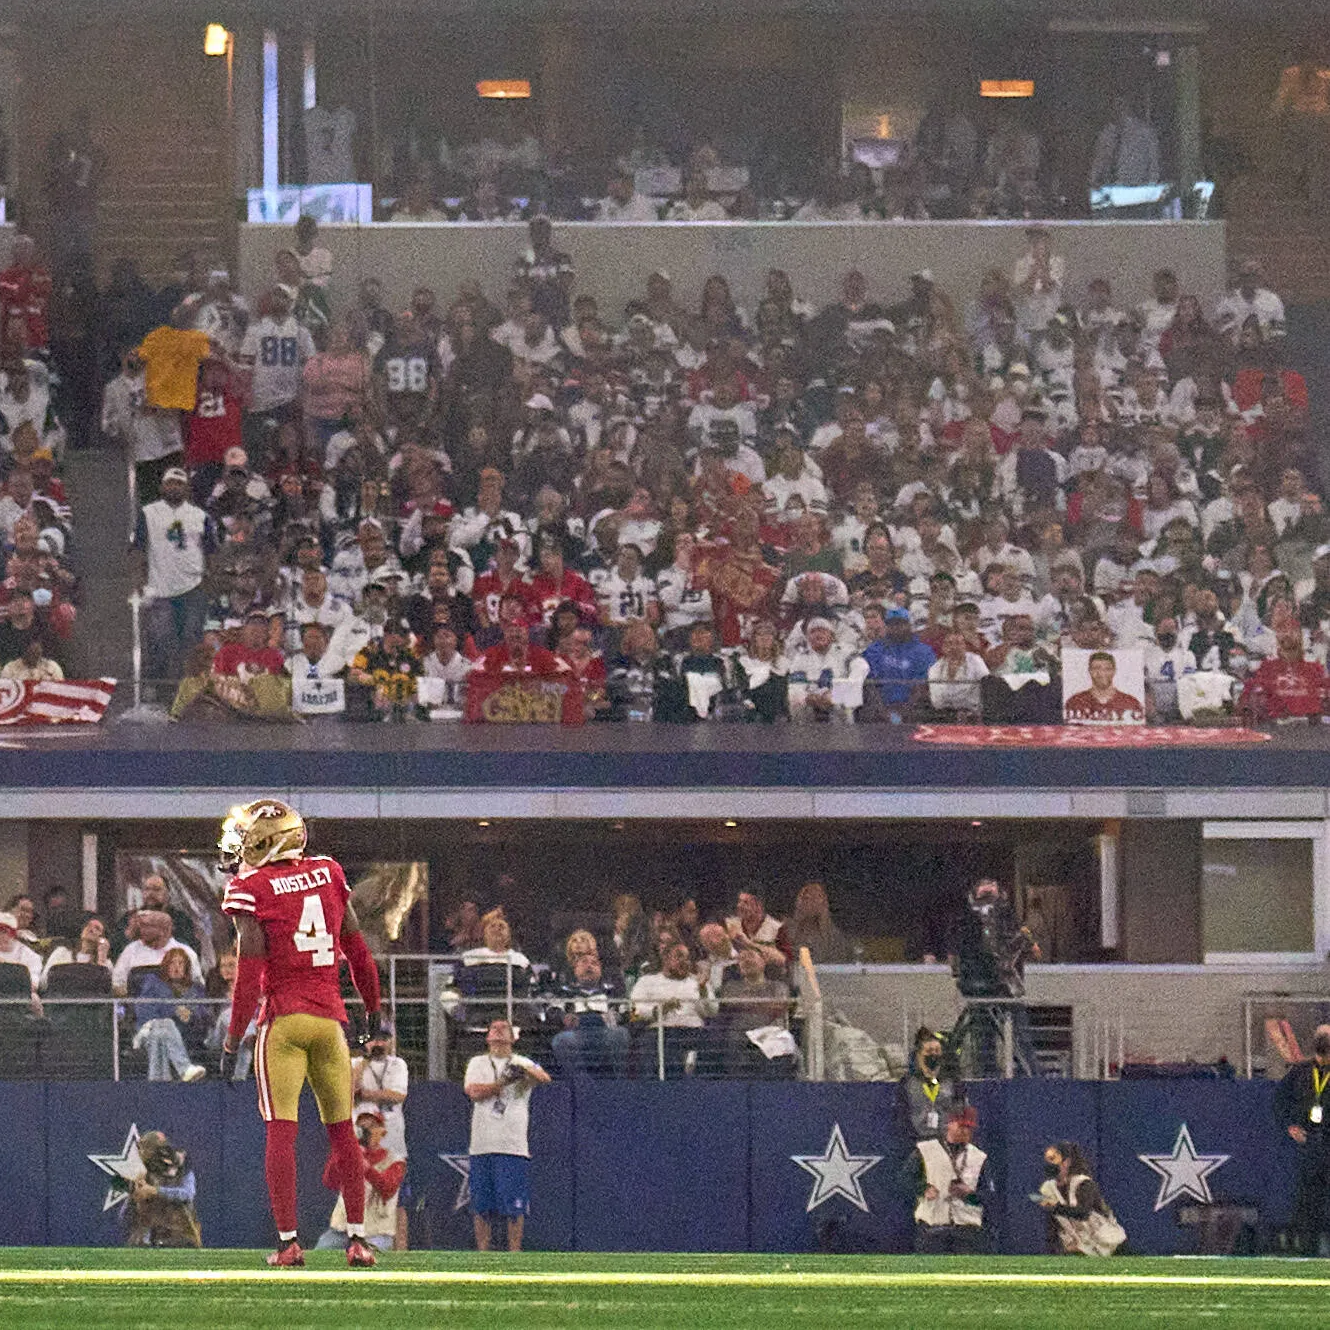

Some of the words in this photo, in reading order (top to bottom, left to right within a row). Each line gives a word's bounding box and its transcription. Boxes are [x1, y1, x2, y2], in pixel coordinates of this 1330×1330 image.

[620, 591, 646, 618] 21
[1160, 660, 1177, 682] 4
[269, 866, 333, 896] MOSELEY
[293, 893, 335, 967] 4
